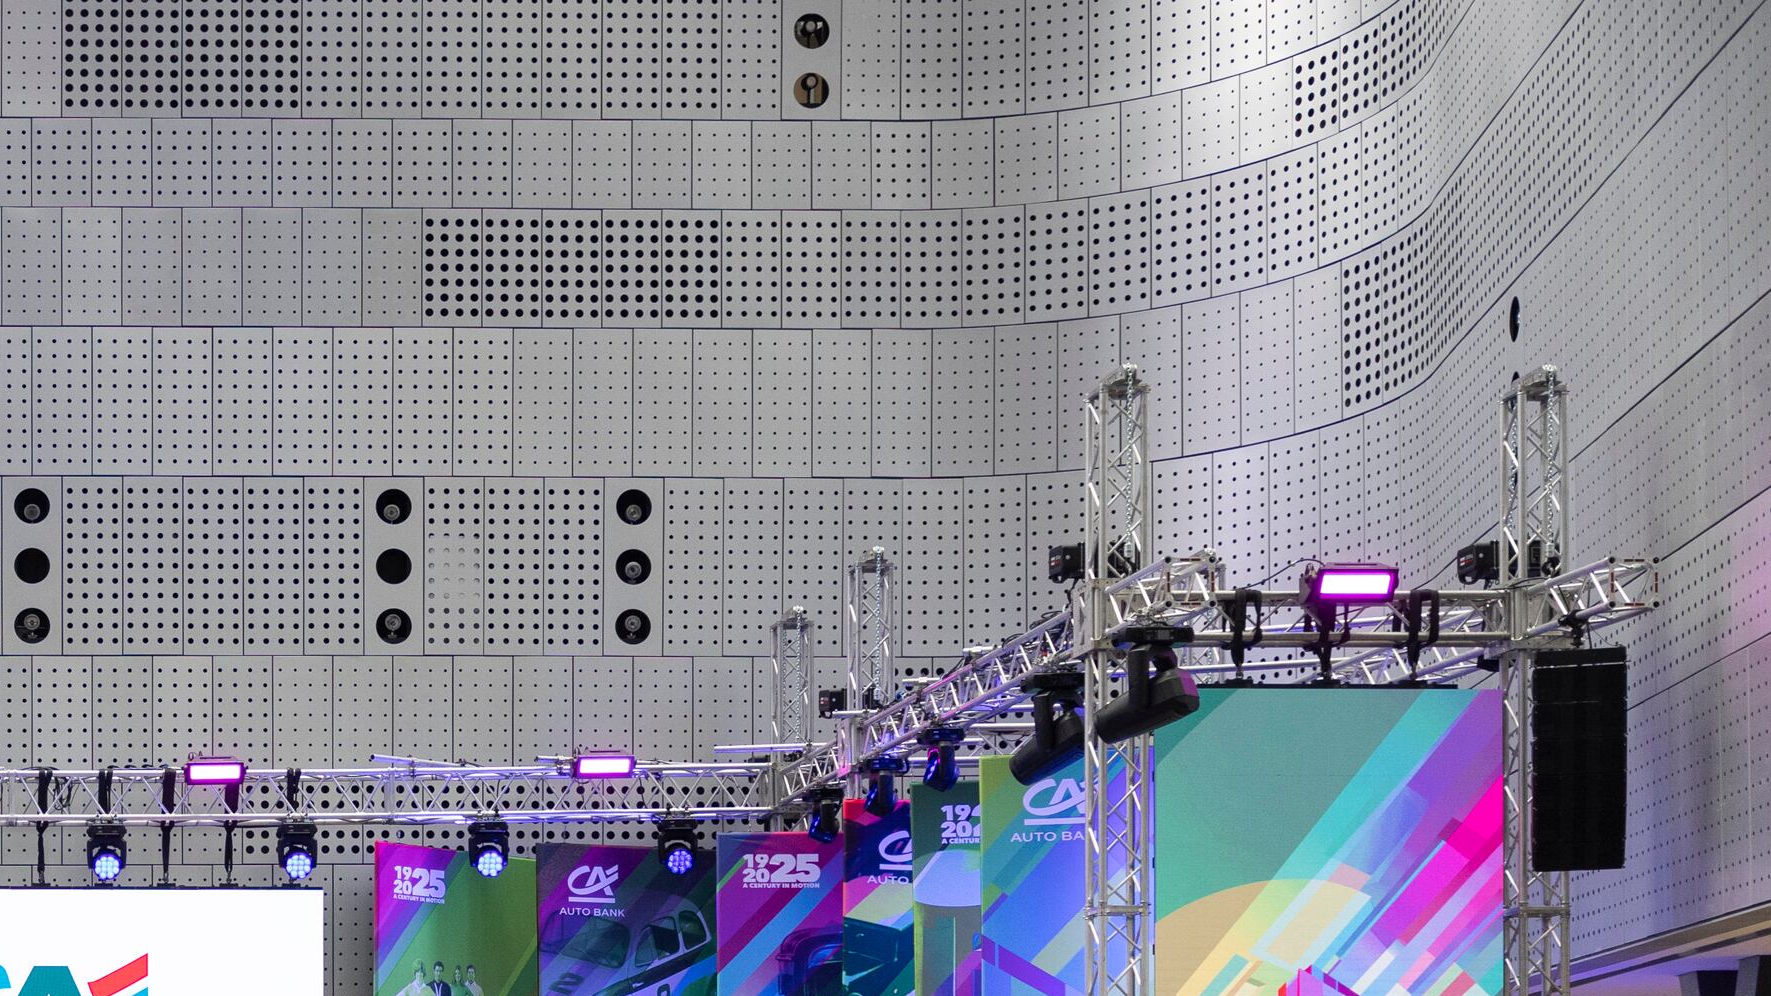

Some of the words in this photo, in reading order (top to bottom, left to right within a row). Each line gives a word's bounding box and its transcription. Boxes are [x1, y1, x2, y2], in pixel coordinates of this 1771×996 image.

[1011, 831, 1057, 842] AUTO
[743, 853, 770, 868] 19
[769, 853, 821, 883] 25
[394, 865, 412, 880] 19
[568, 864, 619, 895] CA
[742, 868, 770, 883] 20
[867, 875, 909, 885] AUTO
[393, 879, 413, 895] 20
[412, 867, 446, 898] 25
[559, 907, 591, 916] AUTO
[593, 908, 626, 917] BANK
